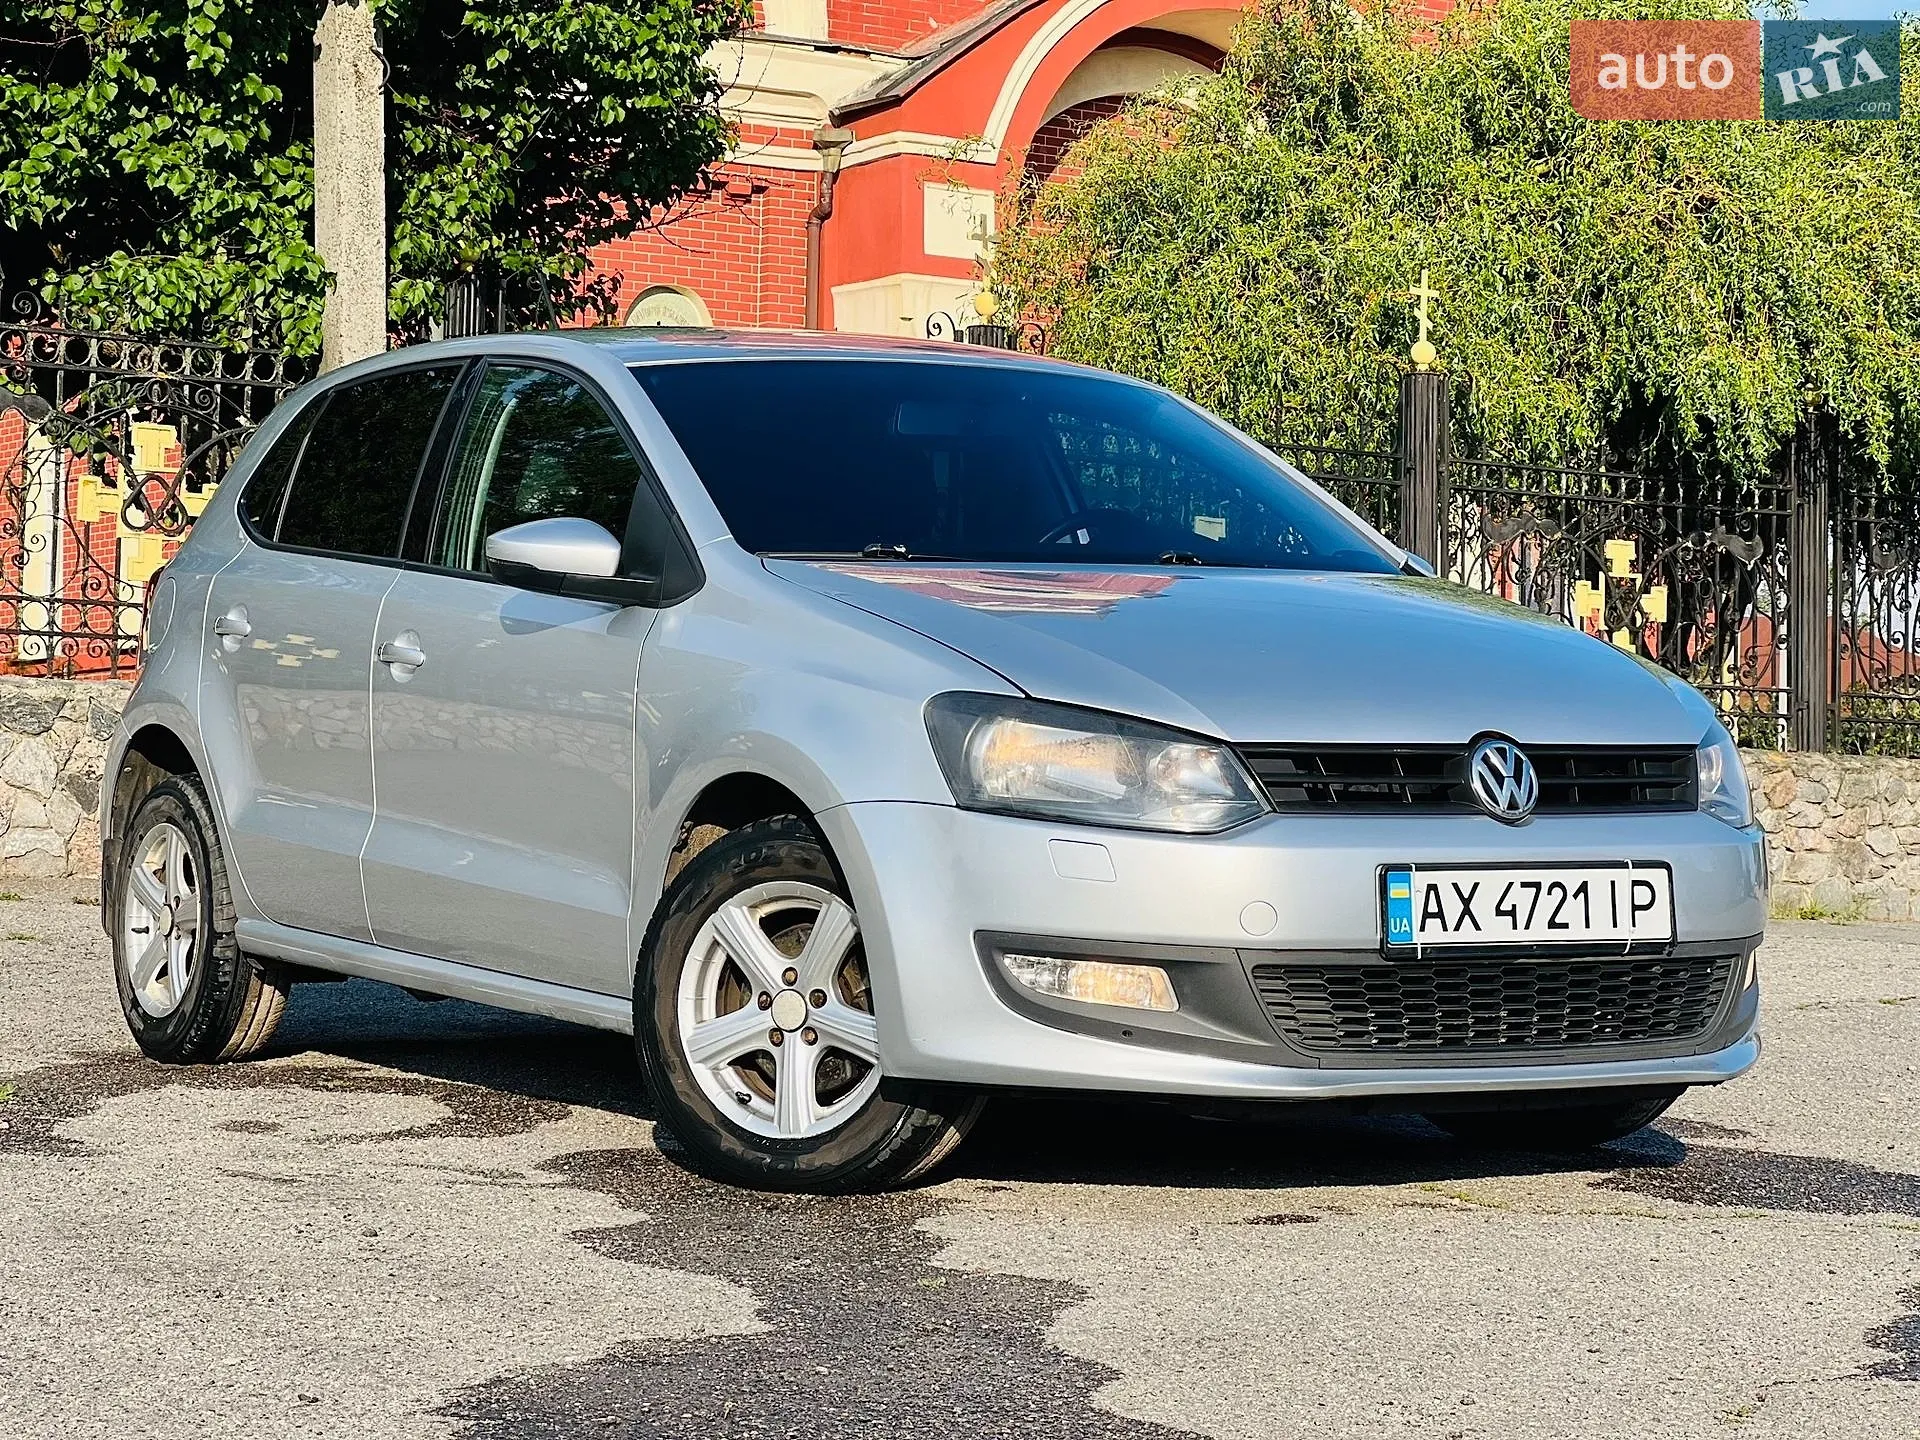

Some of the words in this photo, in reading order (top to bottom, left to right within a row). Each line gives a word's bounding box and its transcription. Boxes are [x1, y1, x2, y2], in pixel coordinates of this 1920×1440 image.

[1472, 743, 1536, 816] VW
[1390, 917, 1411, 934] UA
[1419, 881, 1482, 932] AX
[1494, 880, 1591, 931] 4721
[1610, 879, 1656, 929] IP
